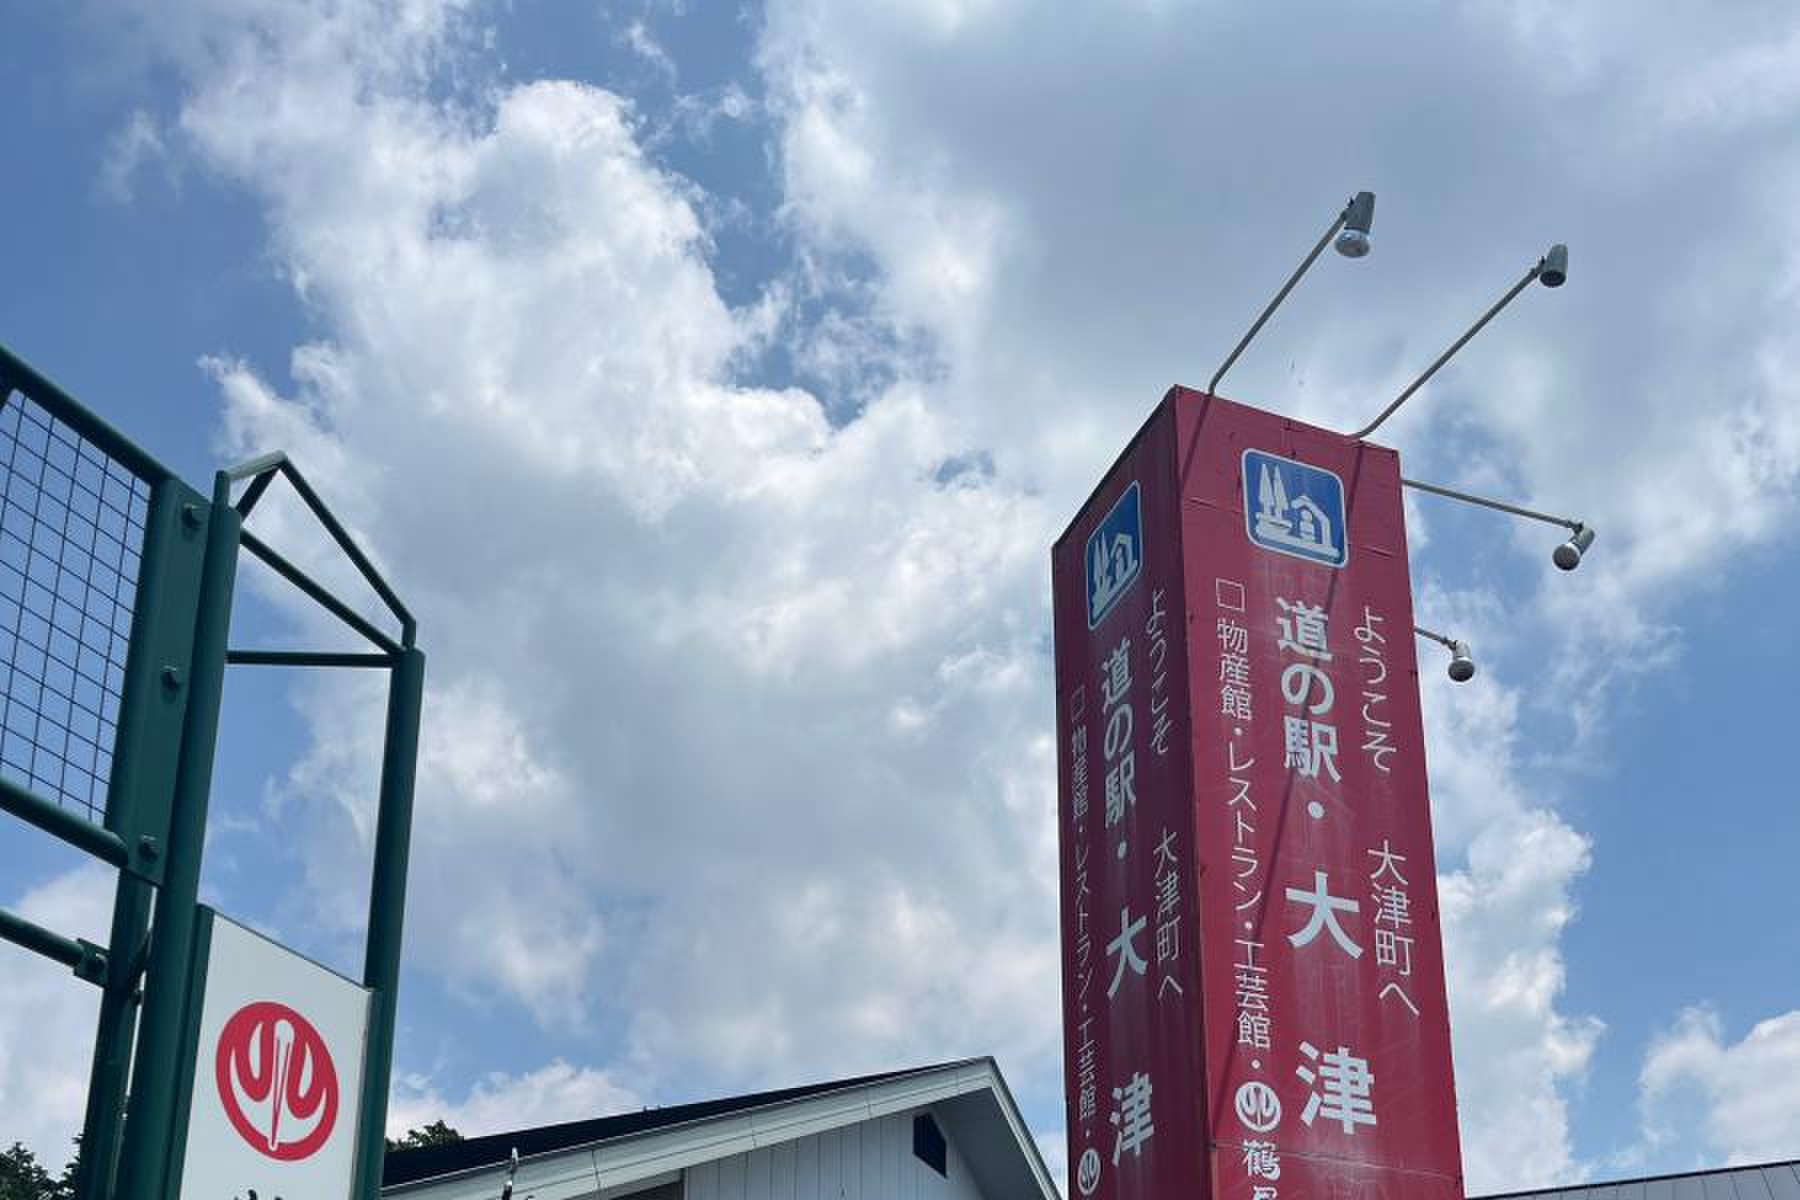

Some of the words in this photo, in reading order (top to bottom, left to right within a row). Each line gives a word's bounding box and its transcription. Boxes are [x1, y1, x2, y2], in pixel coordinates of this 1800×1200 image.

[1354, 606, 1399, 774] ようこそ
[1367, 840, 1421, 1017] 大津町へ
